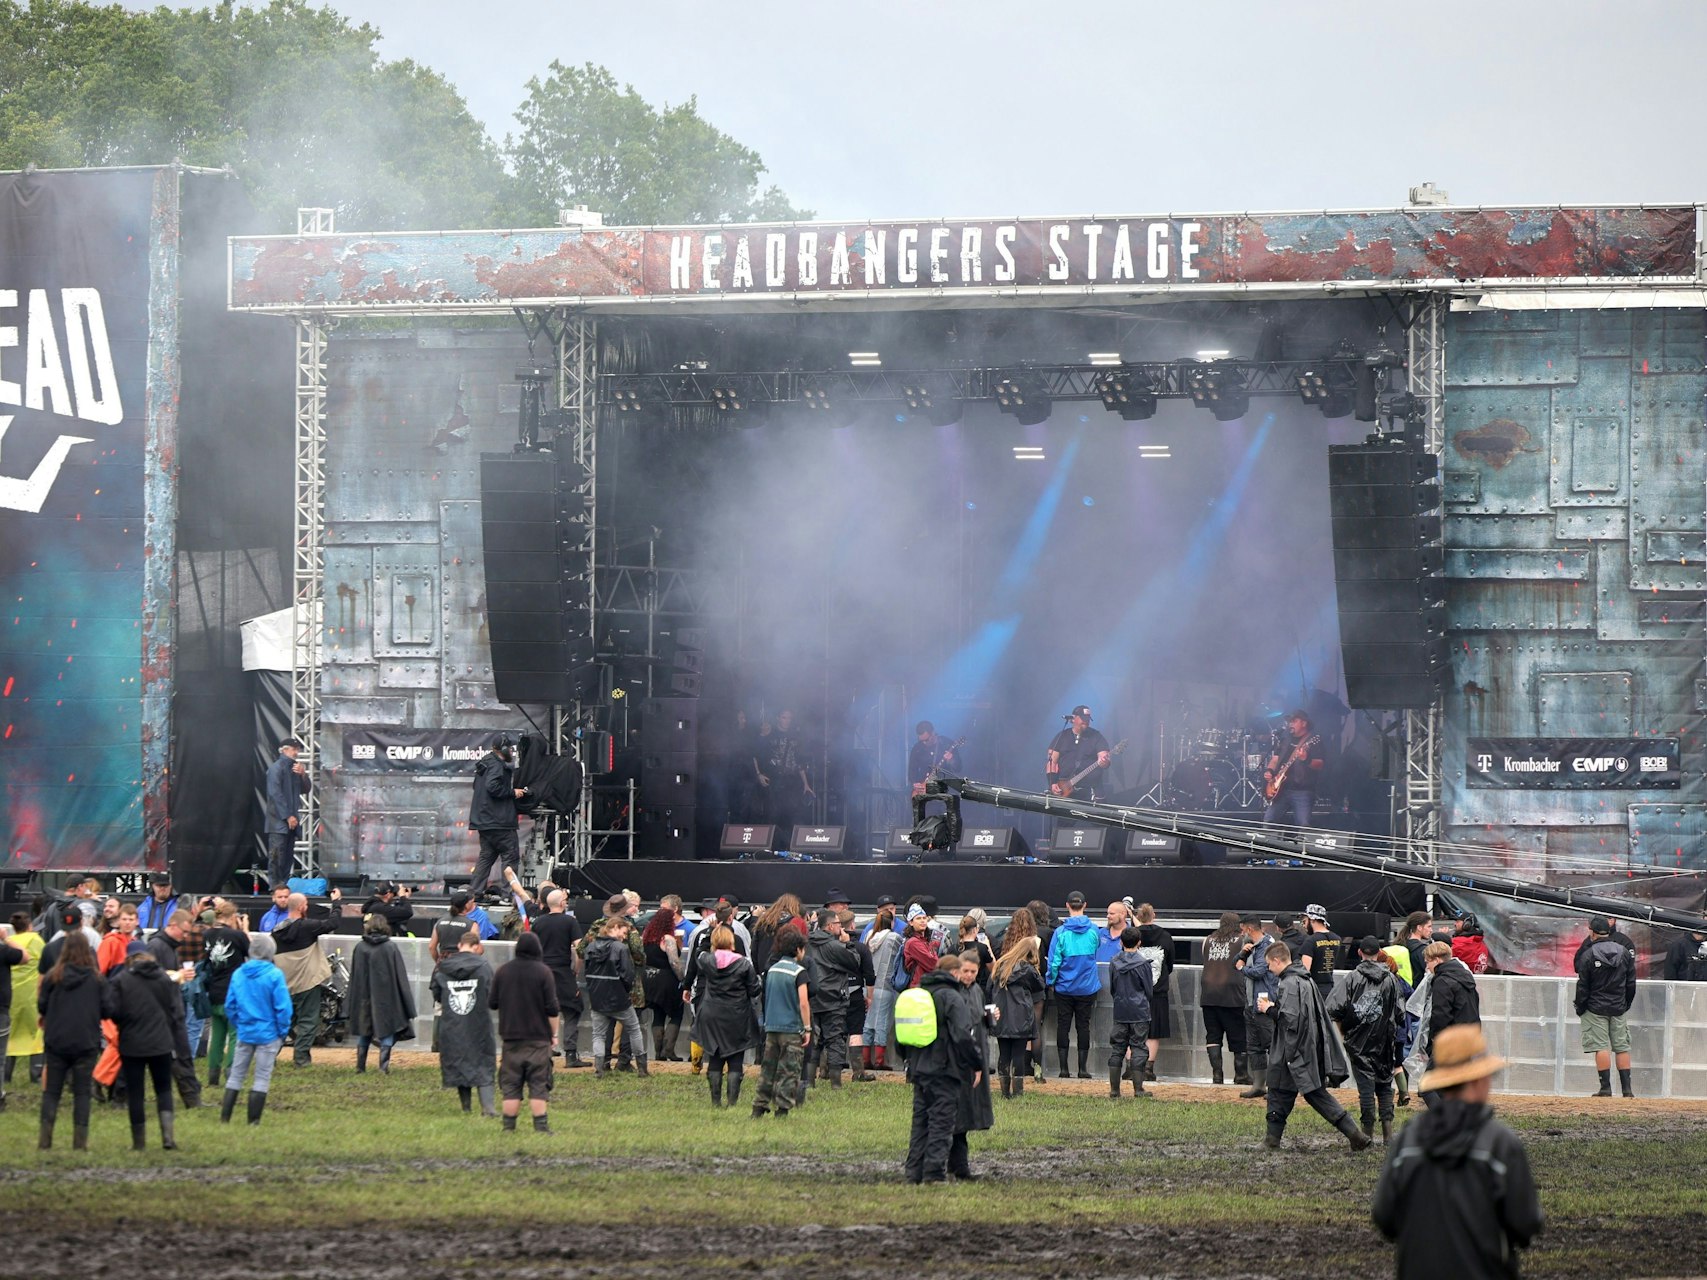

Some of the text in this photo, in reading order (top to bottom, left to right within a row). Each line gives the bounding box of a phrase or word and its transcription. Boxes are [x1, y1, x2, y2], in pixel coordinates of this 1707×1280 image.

[670, 222, 1201, 289] HEADBANGERS STAGE
[386, 746, 423, 760] EMP
[1477, 754, 1492, 773] T
[1504, 756, 1561, 772] Krombacher
[1572, 757, 1615, 772] EMP
